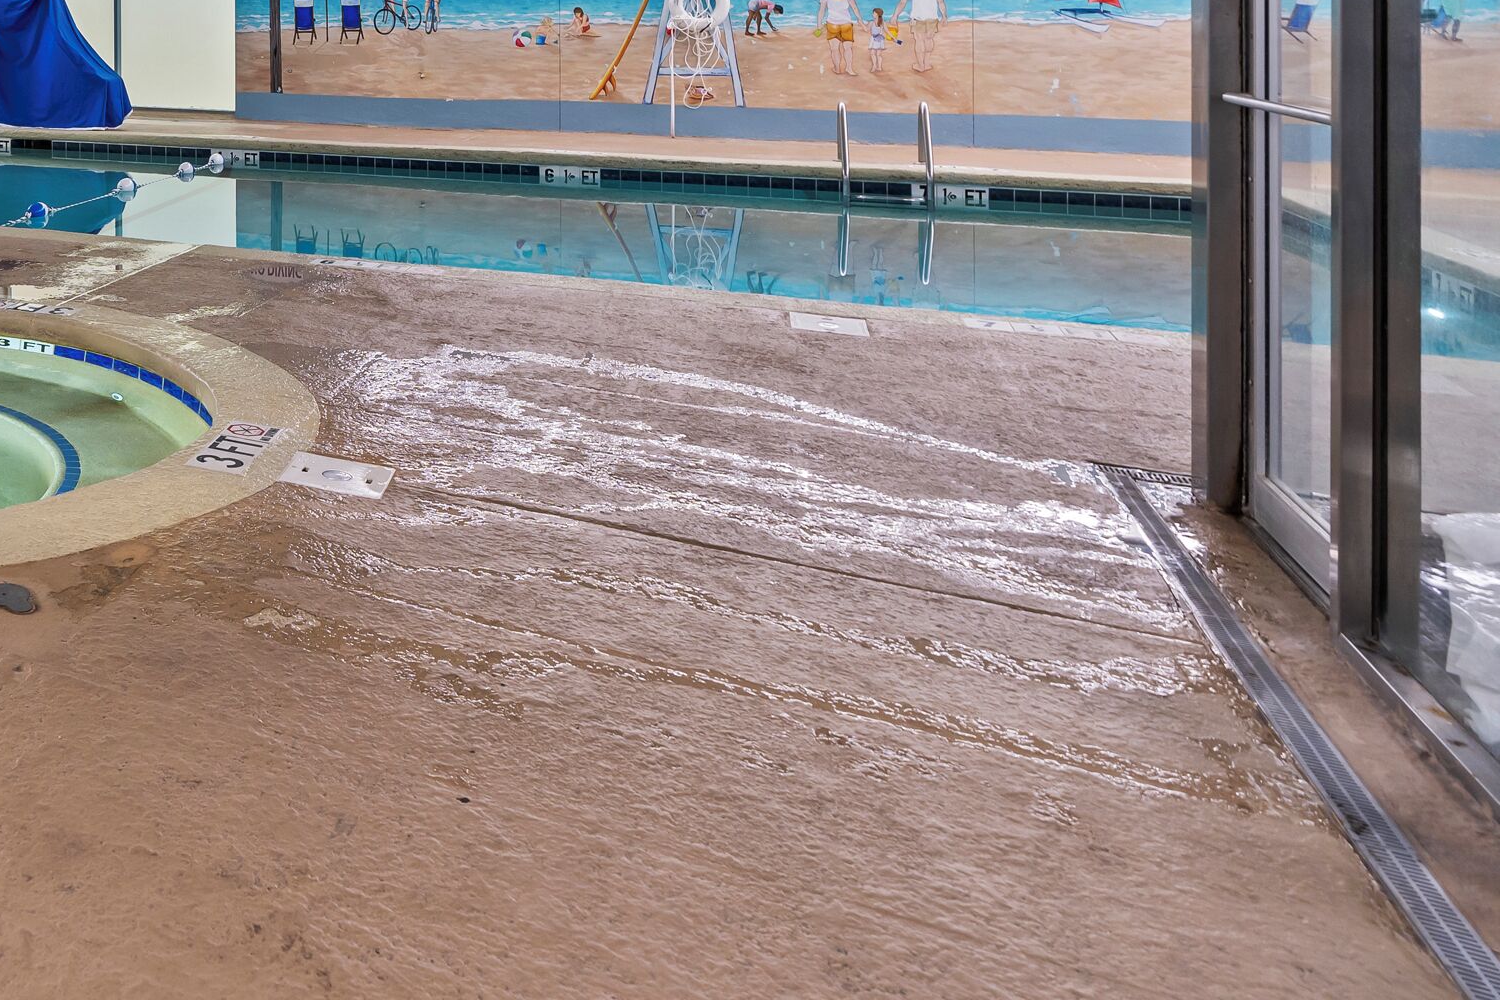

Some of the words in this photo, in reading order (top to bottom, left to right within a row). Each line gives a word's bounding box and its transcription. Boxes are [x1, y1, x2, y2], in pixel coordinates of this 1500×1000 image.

[23, 342, 50, 353] FT
[208, 435, 263, 457] FT
[196, 454, 244, 469] 3
